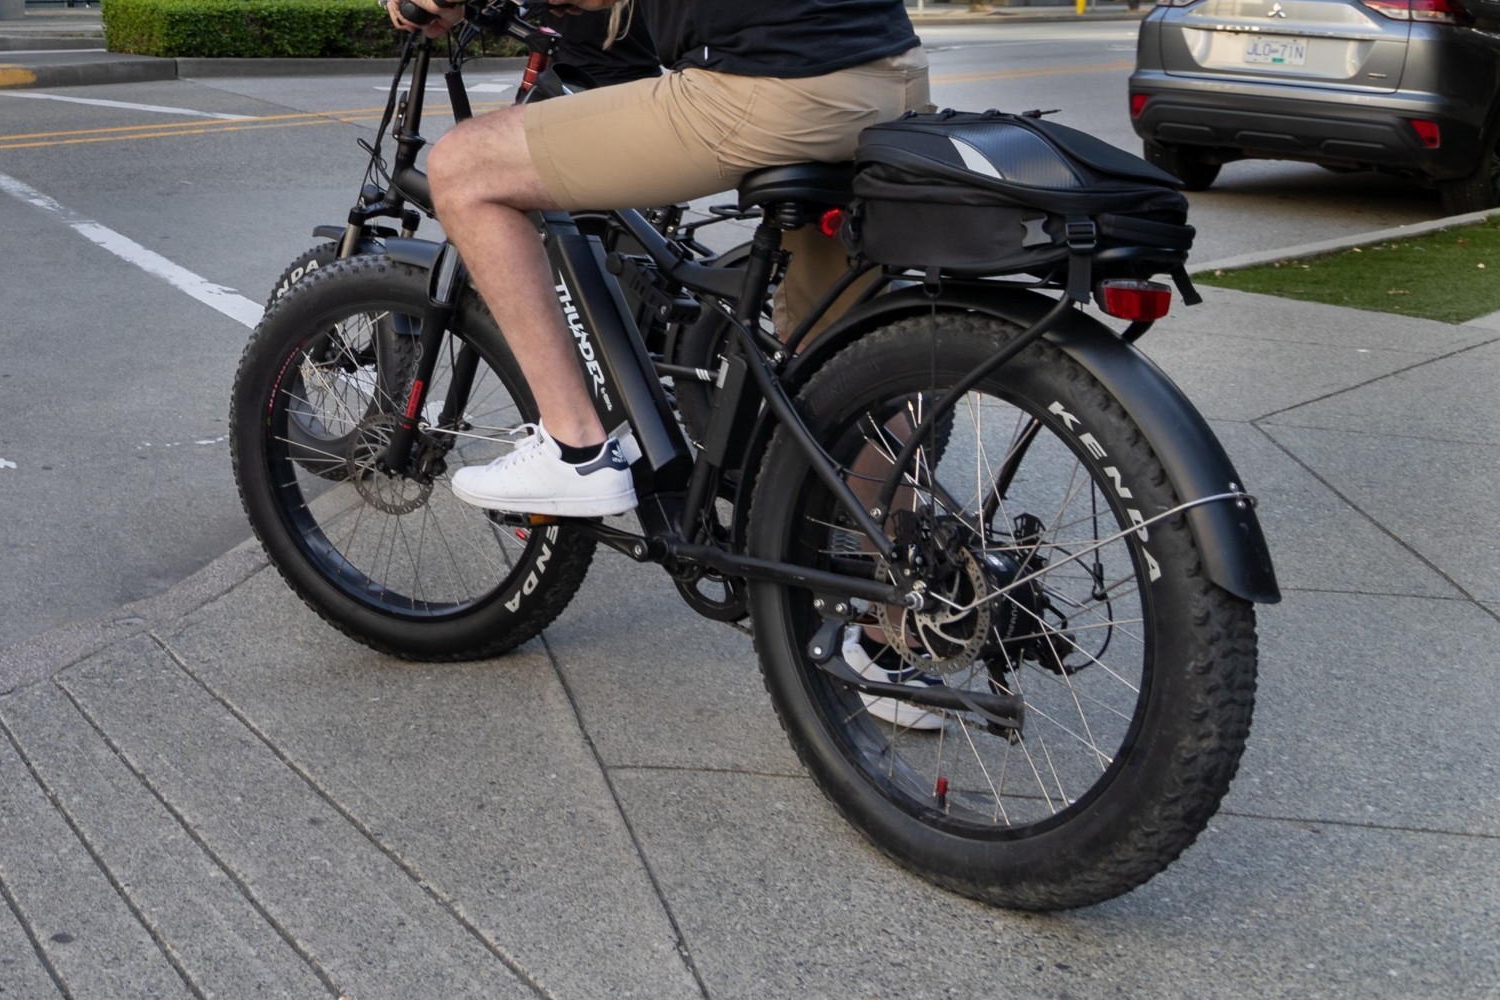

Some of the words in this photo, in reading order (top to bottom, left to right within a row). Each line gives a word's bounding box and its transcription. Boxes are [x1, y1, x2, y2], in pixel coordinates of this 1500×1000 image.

[554, 267, 606, 399] THUNDER
[1047, 400, 1162, 583] KENDA
[504, 525, 560, 614] ENDA
